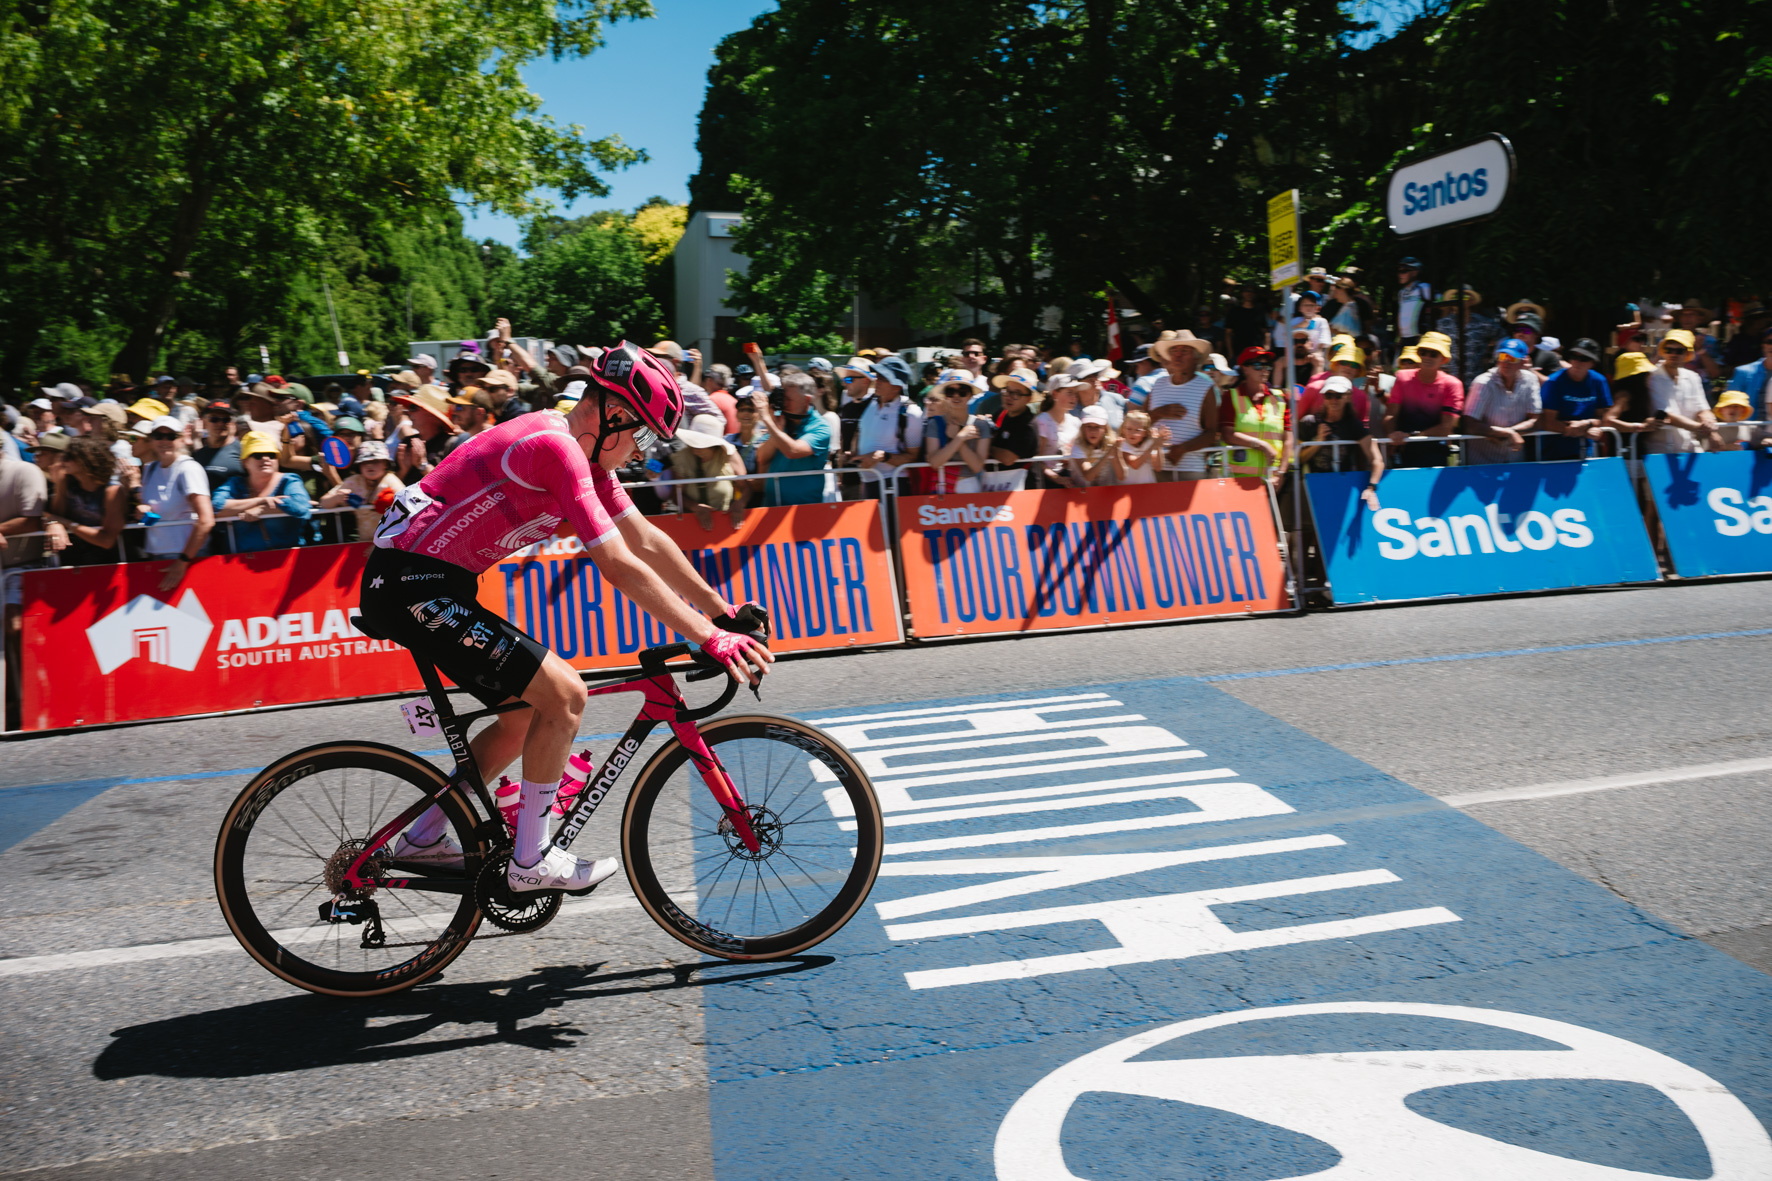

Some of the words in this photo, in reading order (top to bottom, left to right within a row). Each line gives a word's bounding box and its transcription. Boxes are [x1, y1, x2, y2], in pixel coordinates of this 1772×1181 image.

[1403, 168, 1489, 216] Santos
[604, 360, 632, 376] EF
[426, 491, 506, 555] cannondale
[918, 503, 1015, 526] Santos
[1372, 503, 1594, 561] Santos
[400, 572, 445, 582] easypost
[923, 525, 1030, 624] TOUR
[1025, 518, 1146, 618] DOWN
[1141, 510, 1267, 609] UNDER
[498, 557, 609, 661] TOUR
[738, 537, 873, 640] UNDER
[216, 648, 292, 670] SOUTH
[717, 635, 743, 653] EF
[414, 705, 436, 729] 47
[555, 737, 639, 851] cannondale
